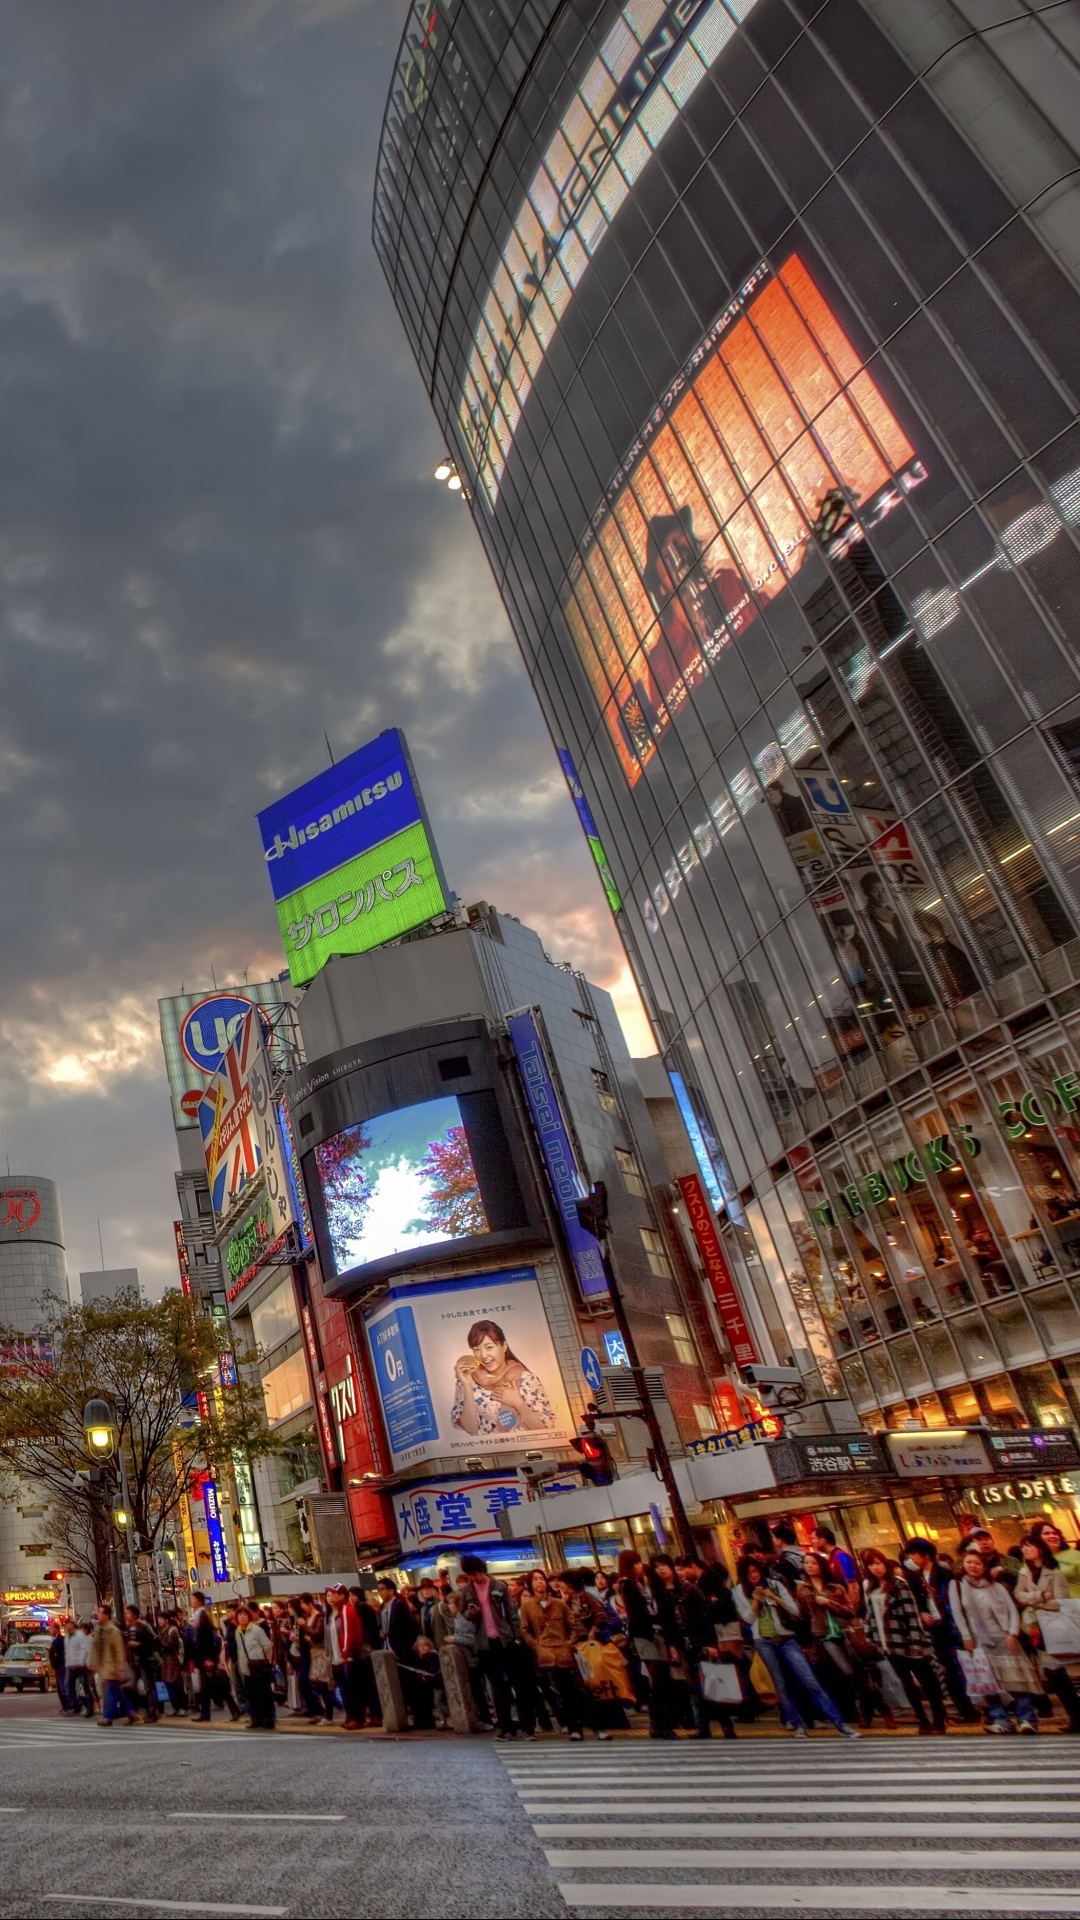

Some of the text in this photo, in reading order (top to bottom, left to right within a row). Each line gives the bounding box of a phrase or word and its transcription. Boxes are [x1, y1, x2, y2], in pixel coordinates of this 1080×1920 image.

[263, 769, 403, 862] Hisamitsu
[287, 857, 424, 950] サロンパス
[306, 1073, 330, 1093] Vision
[332, 1058, 363, 1076] SHIBUYA
[519, 1040, 579, 1220] Taisei neon
[0, 1188, 38, 1197] IBUYA
[684, 1180, 727, 1285] クスリのことなら
[441, 1304, 516, 1320] トクしたお金で食べてます。
[717, 1291, 756, 1362] 三千里
[385, 1348, 404, 1382] 0円
[808, 1456, 854, 1472] 渋谷駅
[207, 1487, 218, 1519] MIZUHO
[399, 1482, 577, 1540] 大盛堂書
[213, 1540, 224, 1576] みずほ銀行
[4, 1591, 55, 1602] SPRING FAIR
